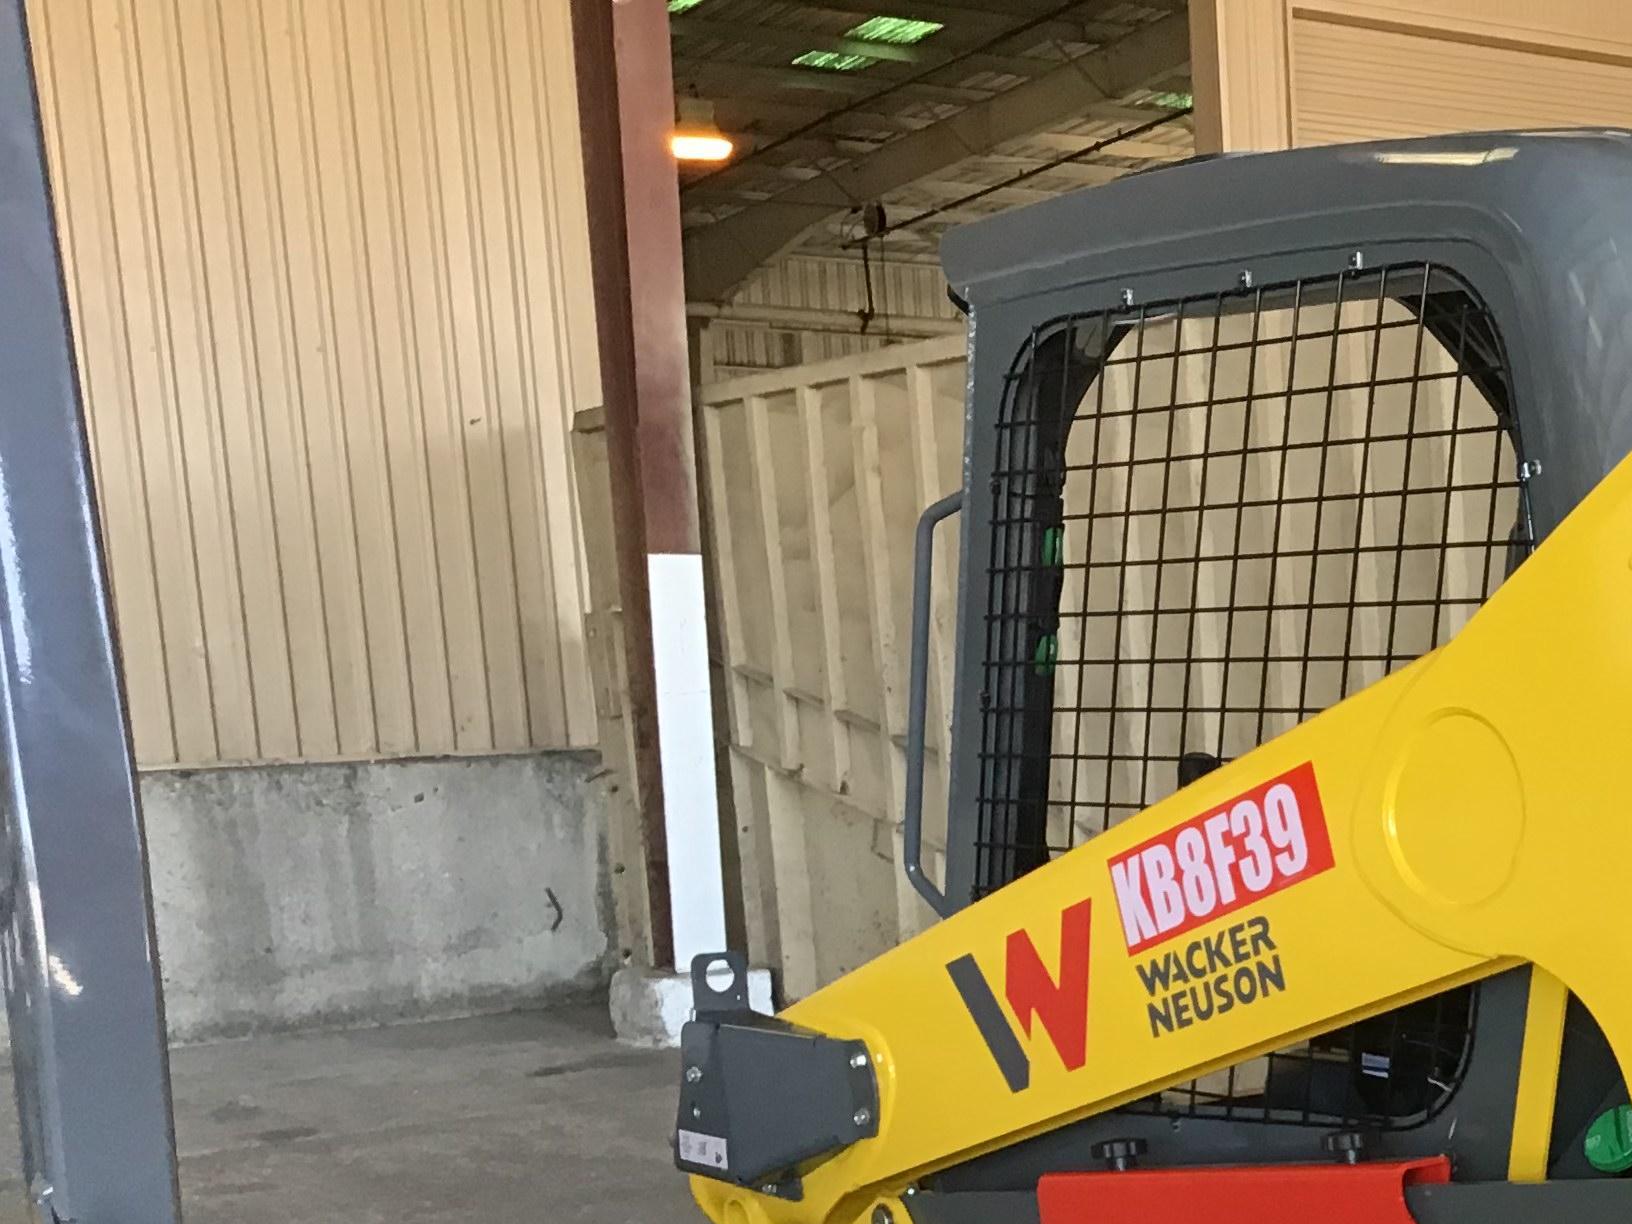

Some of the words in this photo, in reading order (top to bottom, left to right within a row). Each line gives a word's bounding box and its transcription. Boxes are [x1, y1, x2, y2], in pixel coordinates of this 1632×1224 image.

[1111, 784, 1310, 948] KB8F39
[1136, 916, 1277, 997] WACKER
[1147, 955, 1286, 1038] NEUSON
